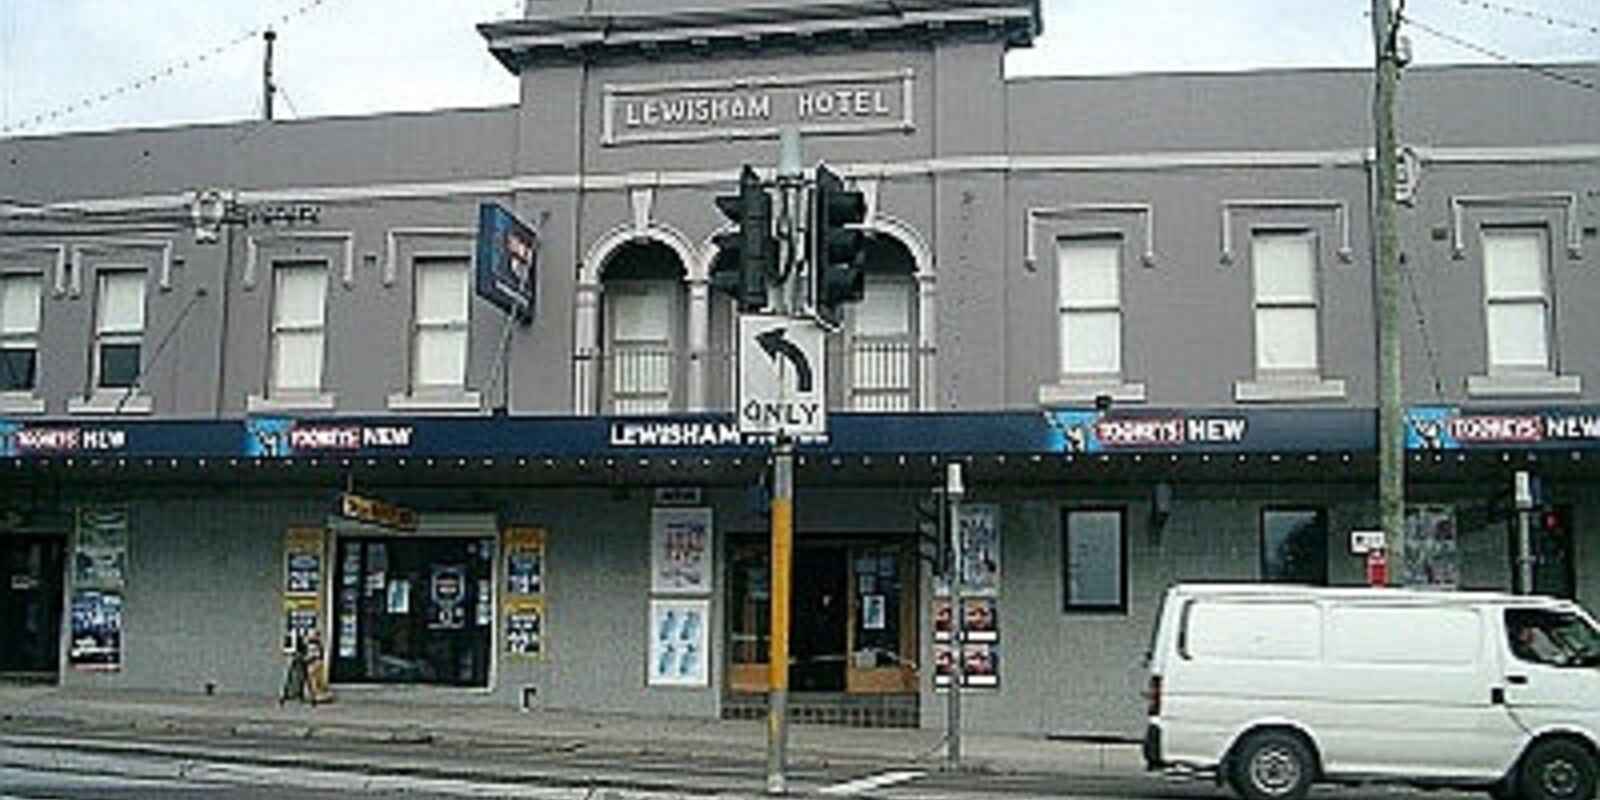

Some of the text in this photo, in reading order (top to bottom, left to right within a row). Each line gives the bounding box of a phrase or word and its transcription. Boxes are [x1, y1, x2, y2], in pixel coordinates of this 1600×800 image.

[626, 90, 889, 126] LEWISHAM HOTEL
[743, 400, 819, 424] ONLY
[363, 426, 413, 446] NEW
[611, 422, 741, 446] LEWISHAM
[1186, 418, 1245, 442] NEW
